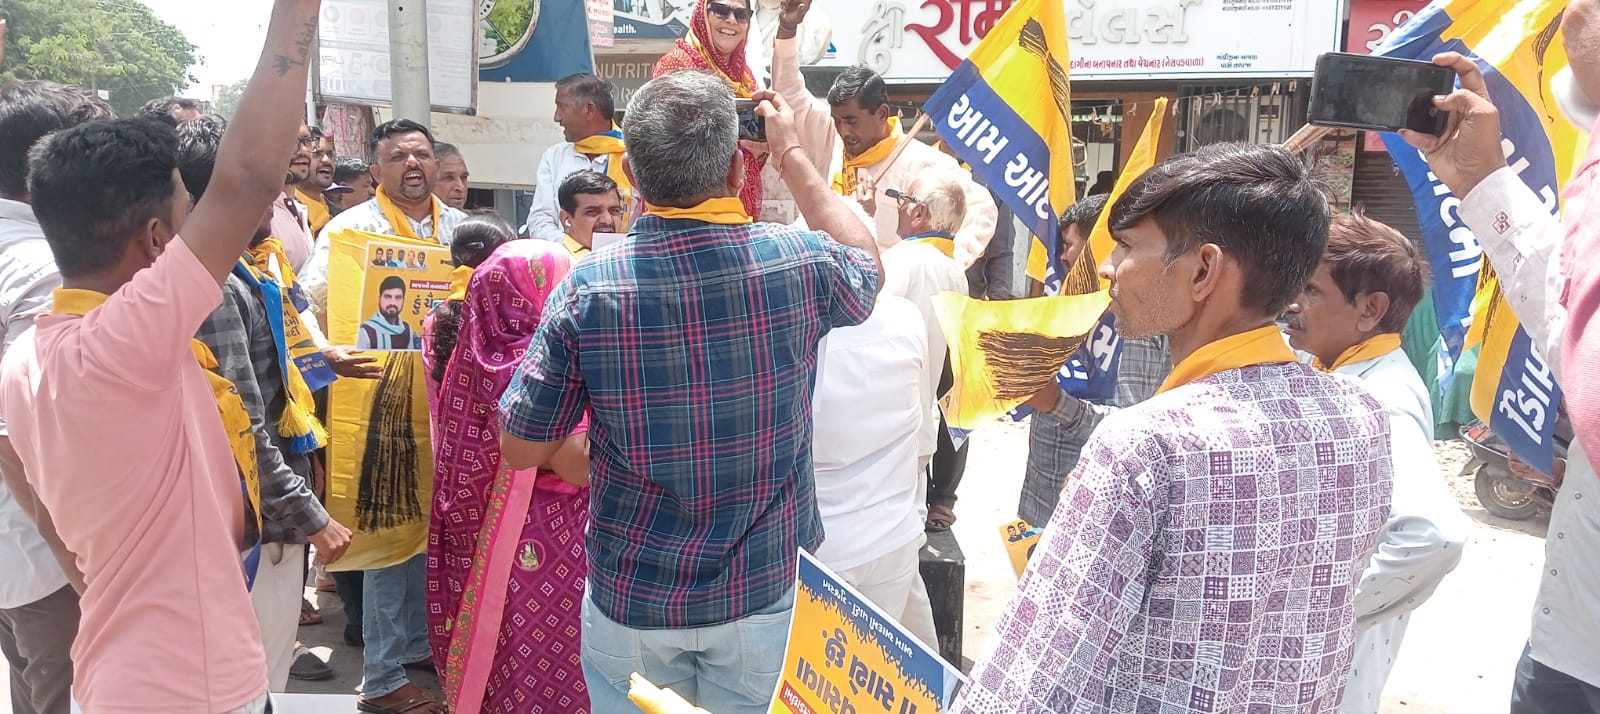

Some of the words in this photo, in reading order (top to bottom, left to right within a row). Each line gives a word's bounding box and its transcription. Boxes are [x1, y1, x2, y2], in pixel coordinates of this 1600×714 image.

[613, 23, 637, 34] ealth.
[1067, 0, 1200, 44] વેલર્સ
[947, 93, 1010, 167] આમ
[1004, 151, 1050, 221] આદ
[849, 654, 896, 711] સાથે
